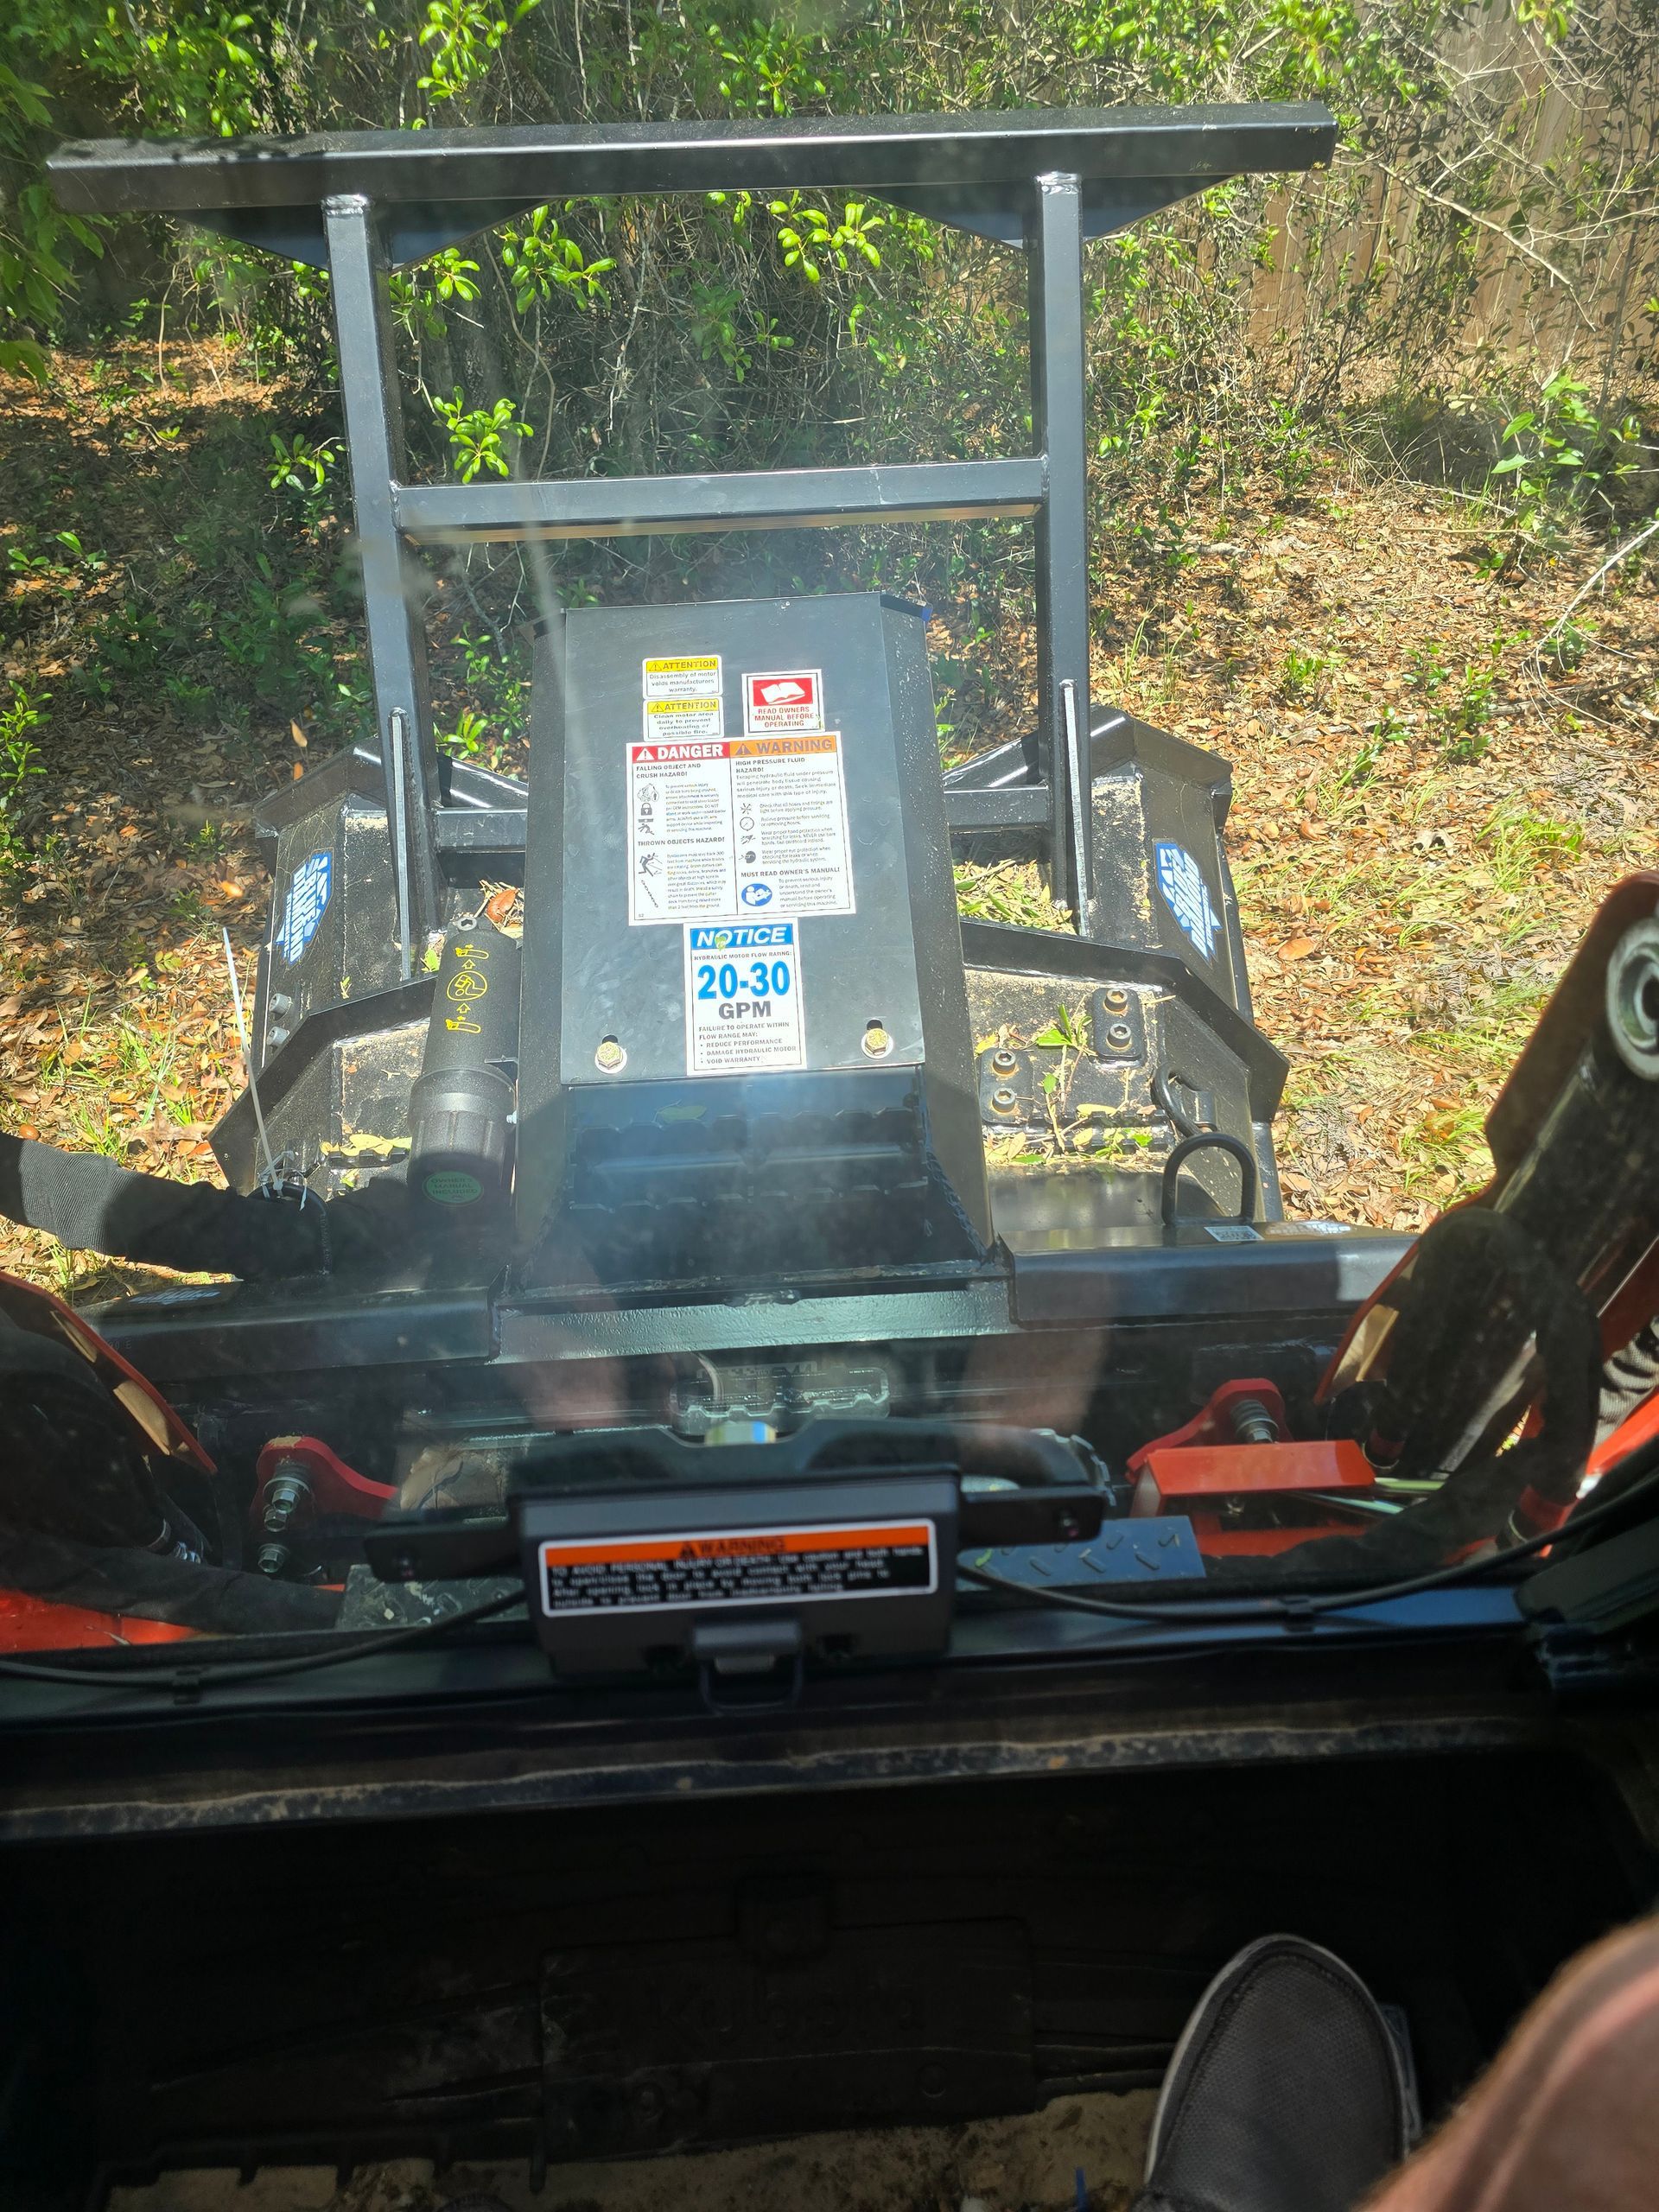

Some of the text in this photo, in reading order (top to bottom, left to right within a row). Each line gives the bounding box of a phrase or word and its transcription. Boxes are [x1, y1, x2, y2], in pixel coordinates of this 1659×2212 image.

[665, 702, 715, 710] ATTENTION
[658, 744, 723, 760] DANGER
[757, 740, 832, 753] WARNING
[303, 870, 317, 925] BLUE
[1172, 857, 1192, 921] BLUE
[290, 864, 306, 962] DIAMOND
[1184, 852, 1208, 957] DIAMOND
[697, 926, 786, 947] NOTICE
[698, 961, 790, 1000] 20-30
[719, 1001, 771, 1020] GPM
[699, 1536, 785, 1556] WARNING
